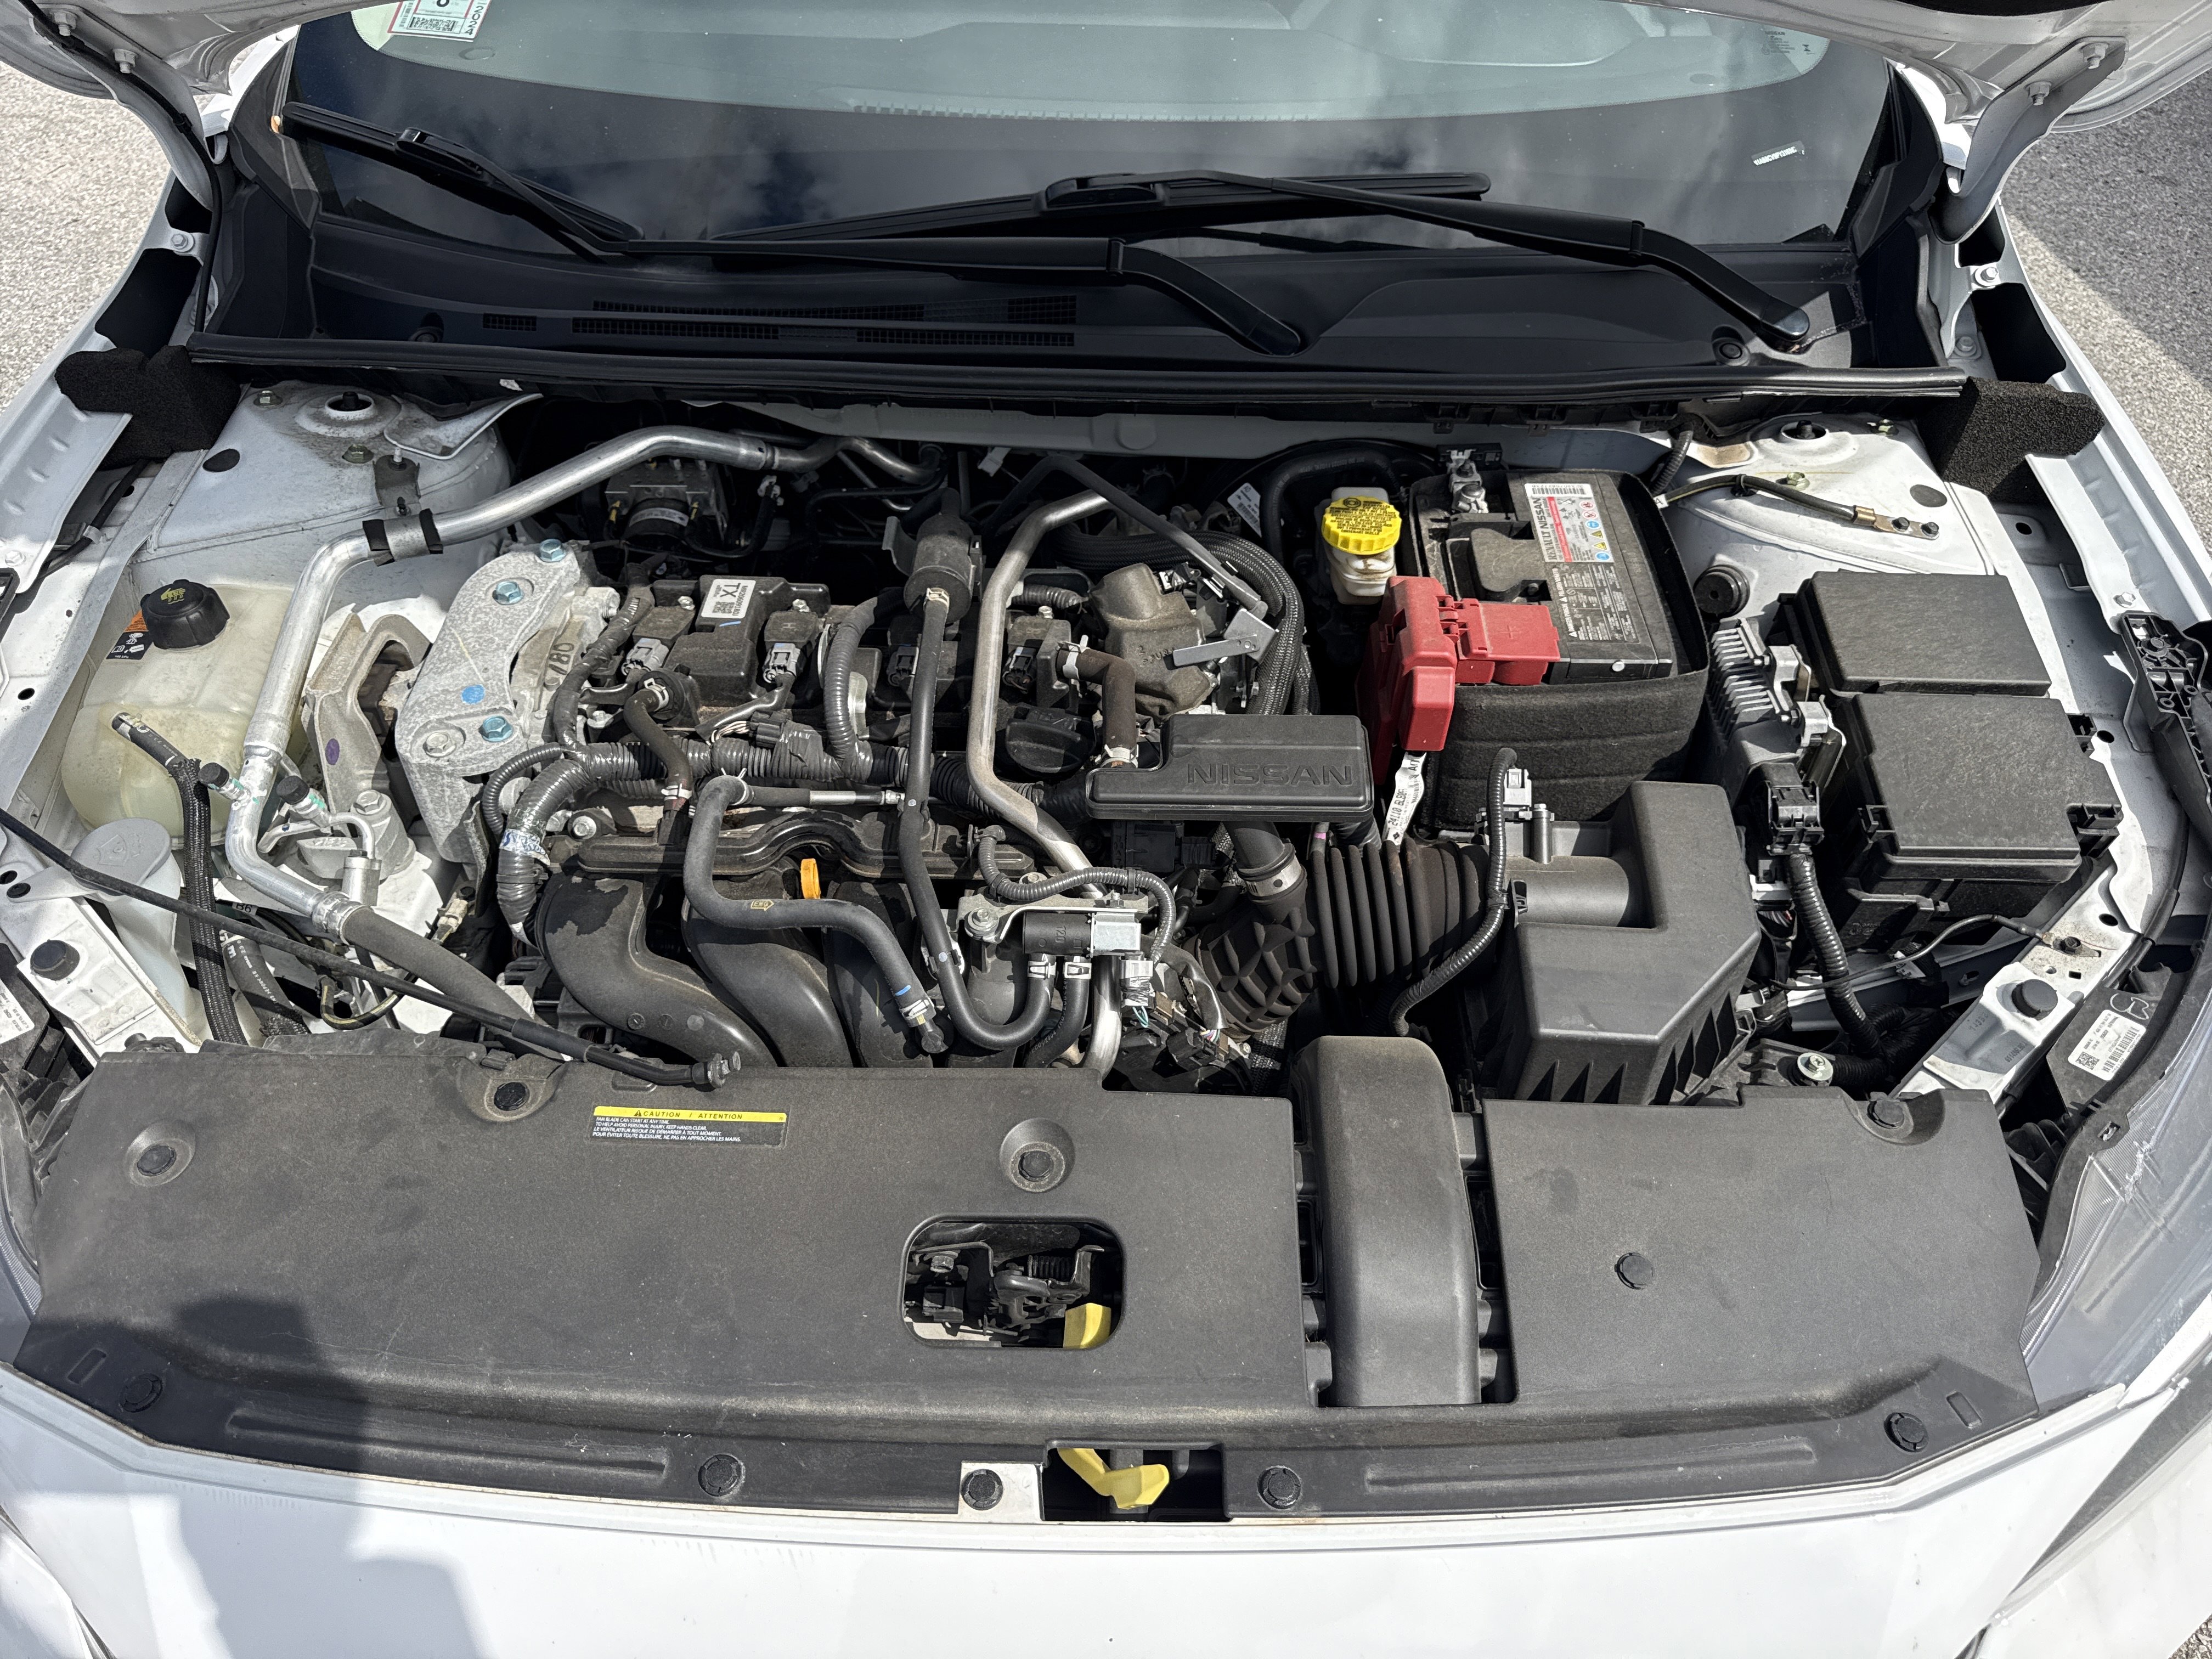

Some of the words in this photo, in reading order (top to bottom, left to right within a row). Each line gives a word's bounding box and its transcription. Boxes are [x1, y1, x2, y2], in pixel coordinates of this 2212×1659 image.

[1533, 498, 1550, 529] NISSAN
[1541, 531, 1558, 560] RENAULT
[718, 582, 741, 599] TX
[1188, 763, 1352, 786] NISSAN
[1055, 926, 1066, 944] 120
